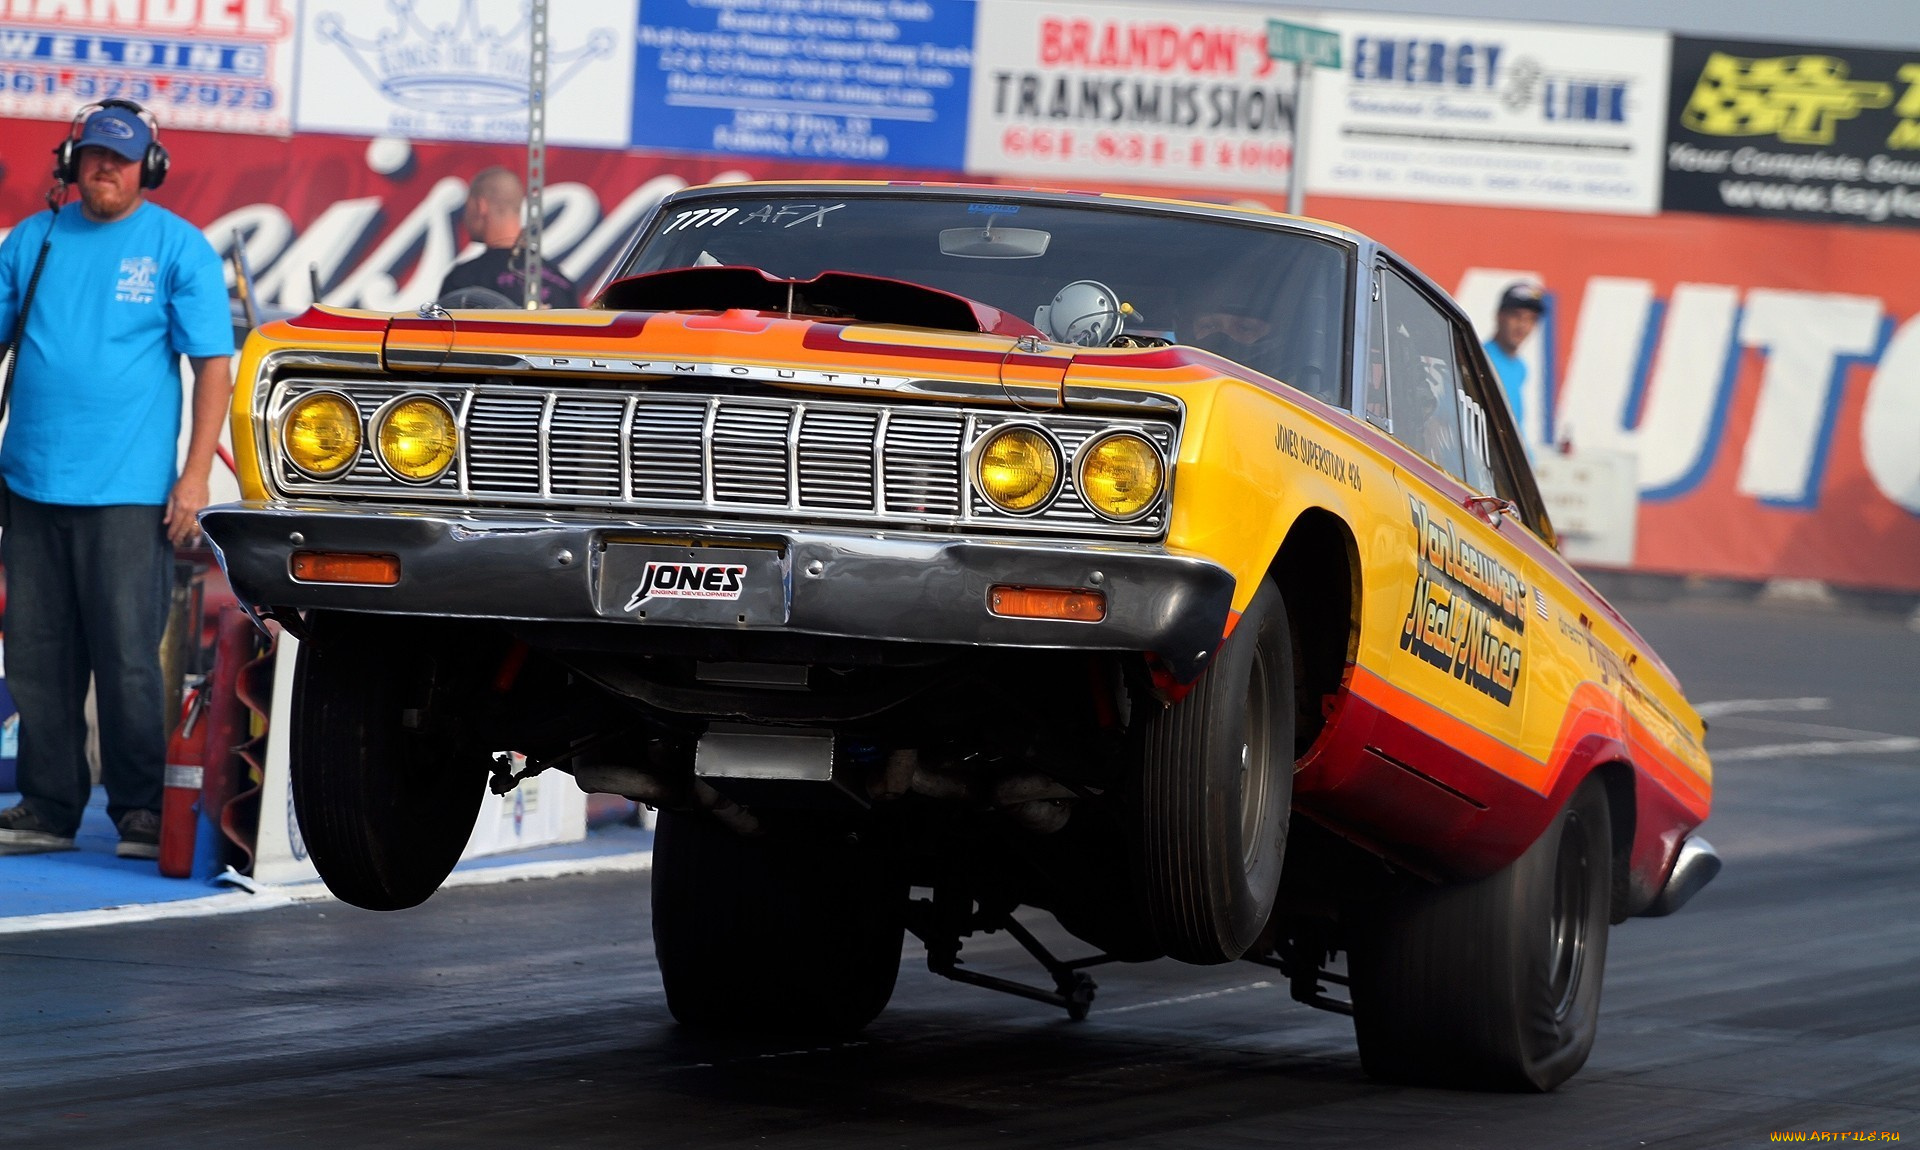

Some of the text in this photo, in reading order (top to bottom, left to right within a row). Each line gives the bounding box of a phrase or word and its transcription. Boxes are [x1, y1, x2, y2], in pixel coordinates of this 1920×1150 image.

[0, 32, 262, 73] WELDING
[1041, 19, 1274, 75] BRANDON'S
[1352, 37, 1503, 88] ENERGY
[993, 72, 1296, 132] TRANSMISSION
[1543, 80, 1627, 121] LINK
[738, 203, 847, 229] AFX
[550, 357, 882, 386] PLYMOUTH
[1275, 422, 1362, 493] JONES SUPERSTOCK 426
[628, 565, 744, 608] JONES
[681, 590, 738, 598] DEVELOPMENT
